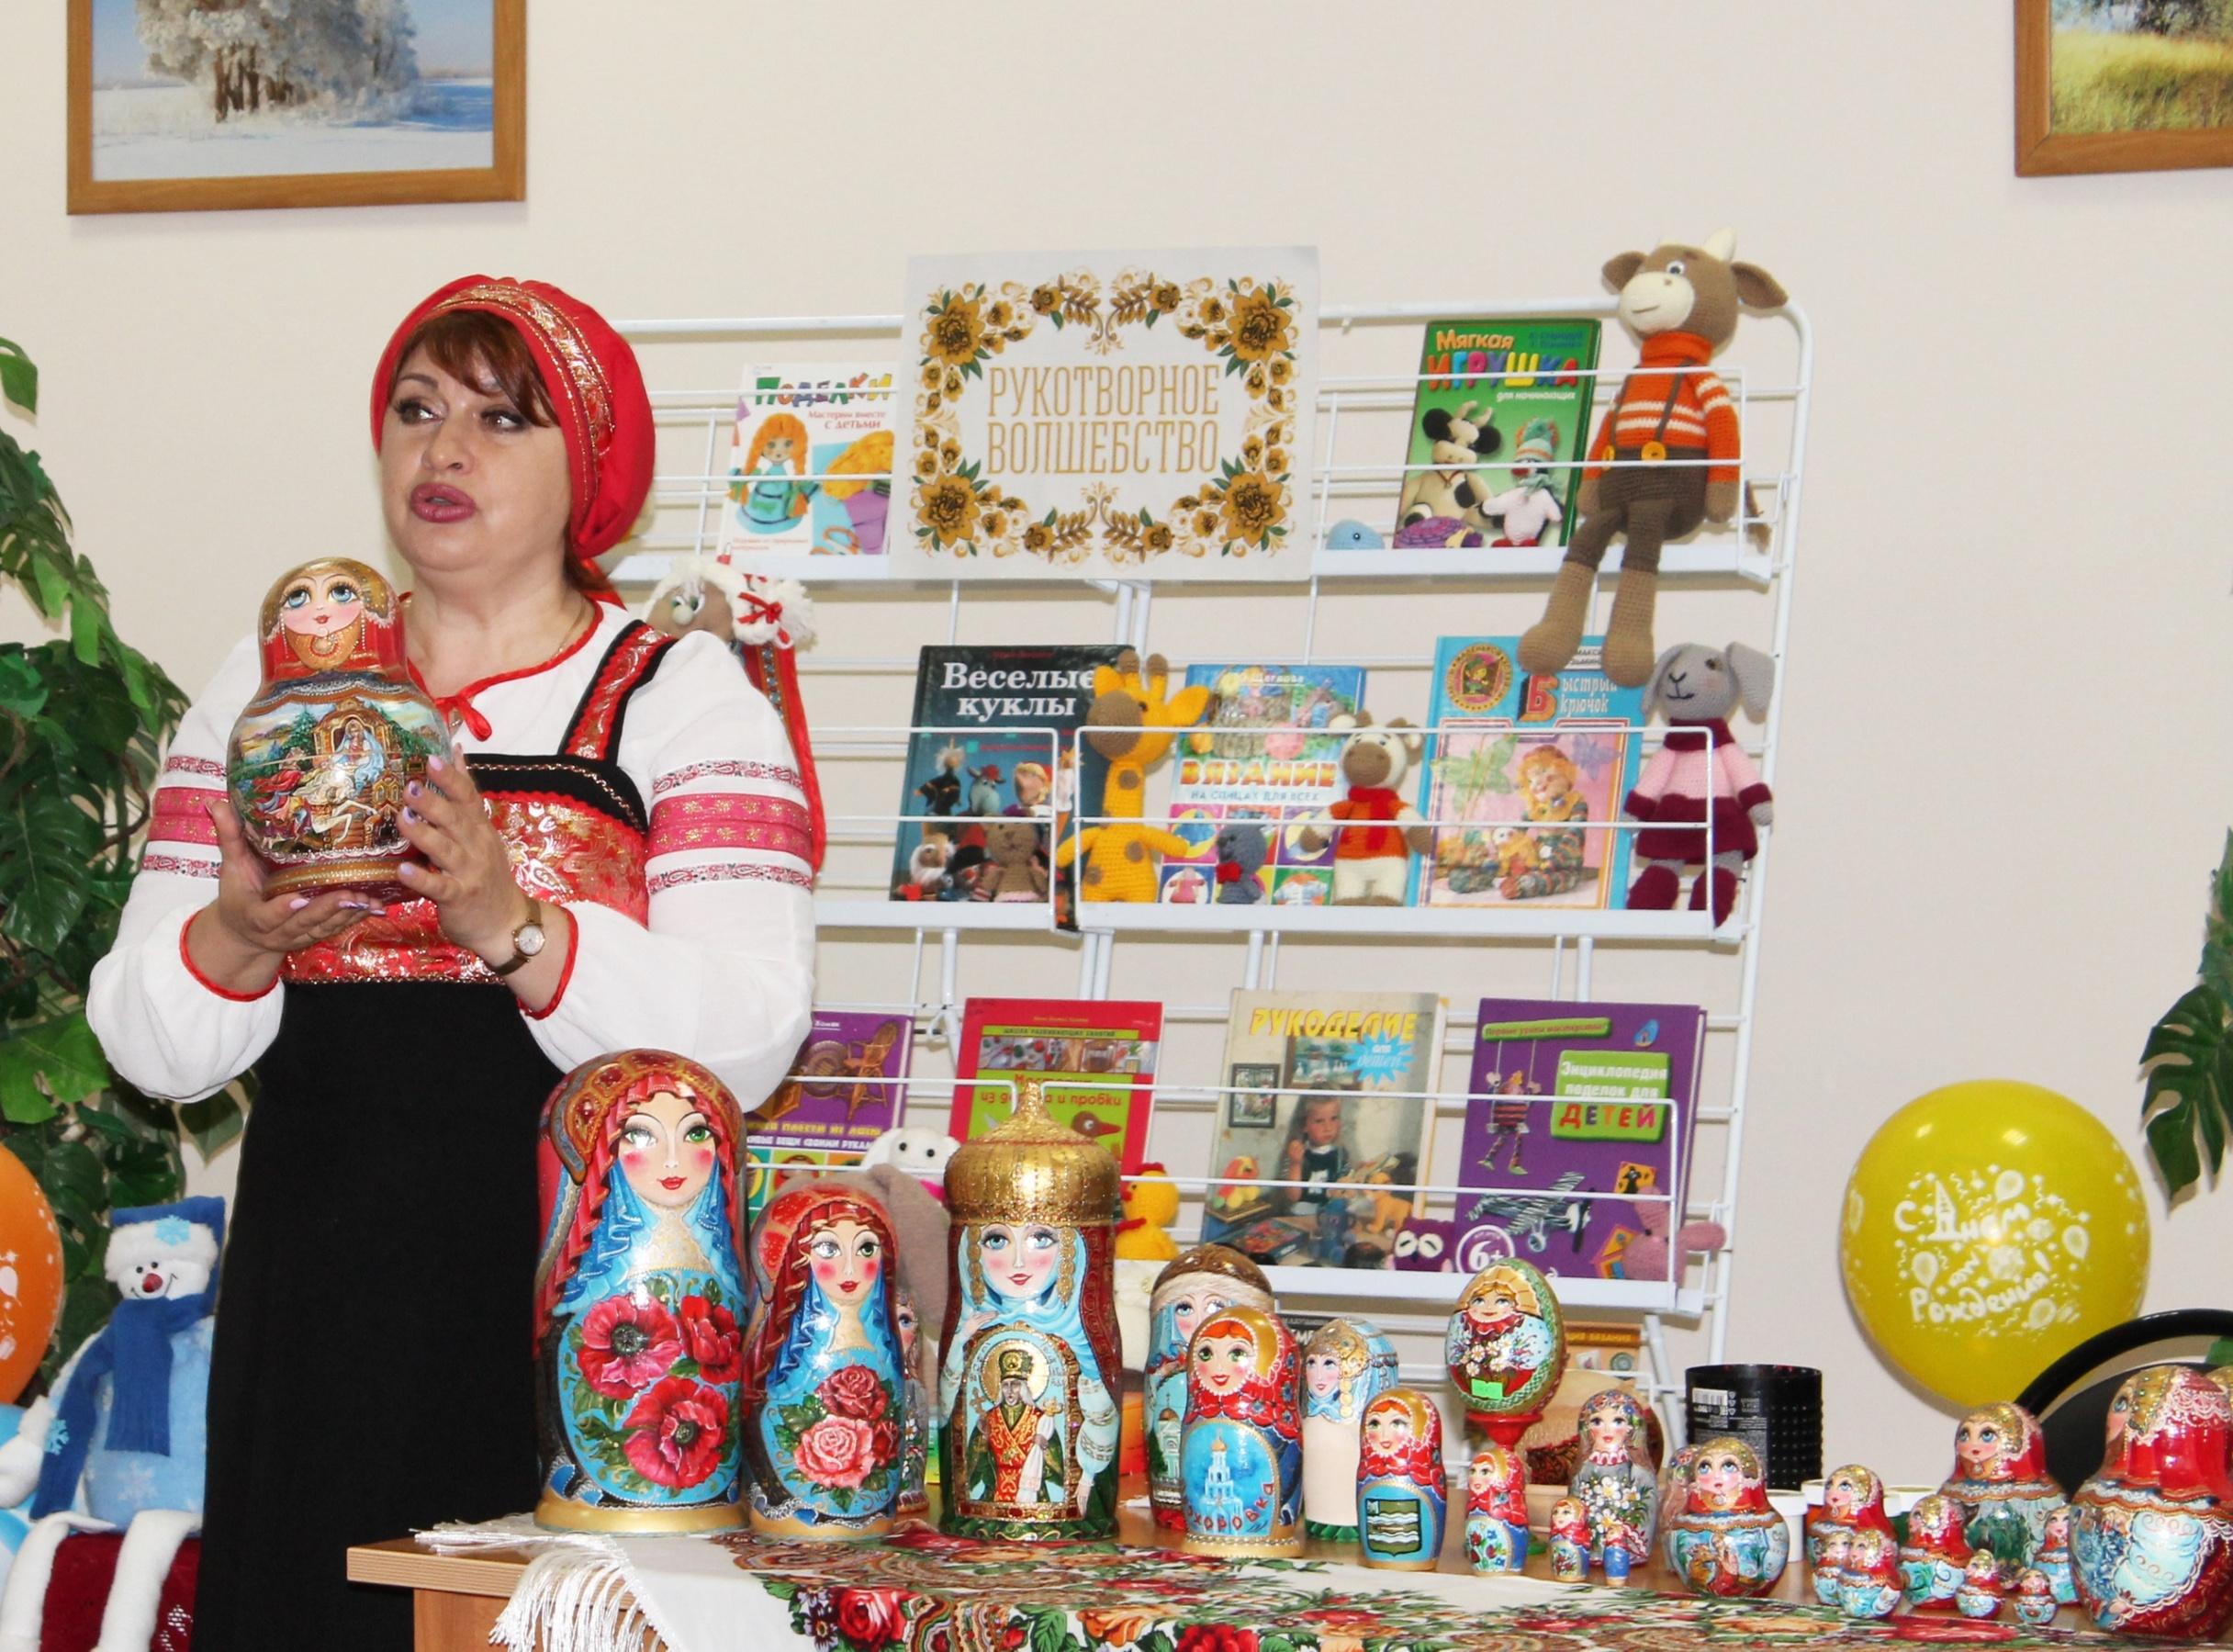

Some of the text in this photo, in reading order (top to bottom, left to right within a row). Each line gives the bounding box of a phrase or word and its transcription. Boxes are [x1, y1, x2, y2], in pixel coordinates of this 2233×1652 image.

[1436, 330, 1513, 351] Мягкая
[1427, 351, 1578, 391] ИГРУШКА
[988, 365, 1219, 417] РУКОТВОРНОЕ
[986, 420, 1219, 474] ВОЛШЕБСТВО
[940, 662, 1096, 690] Веселые
[957, 697, 1077, 723] куклы
[1180, 760, 1338, 788] ВЯЗАНИЕ
[1249, 1008, 1418, 1041] РУКОДЕЛИЕ
[1561, 1061, 1668, 1081] Энциклопедия
[1070, 1093, 1122, 1107] пробки
[1559, 1102, 1656, 1129] ДЕТЕЙ
[1469, 1241, 1505, 1271] 6+
